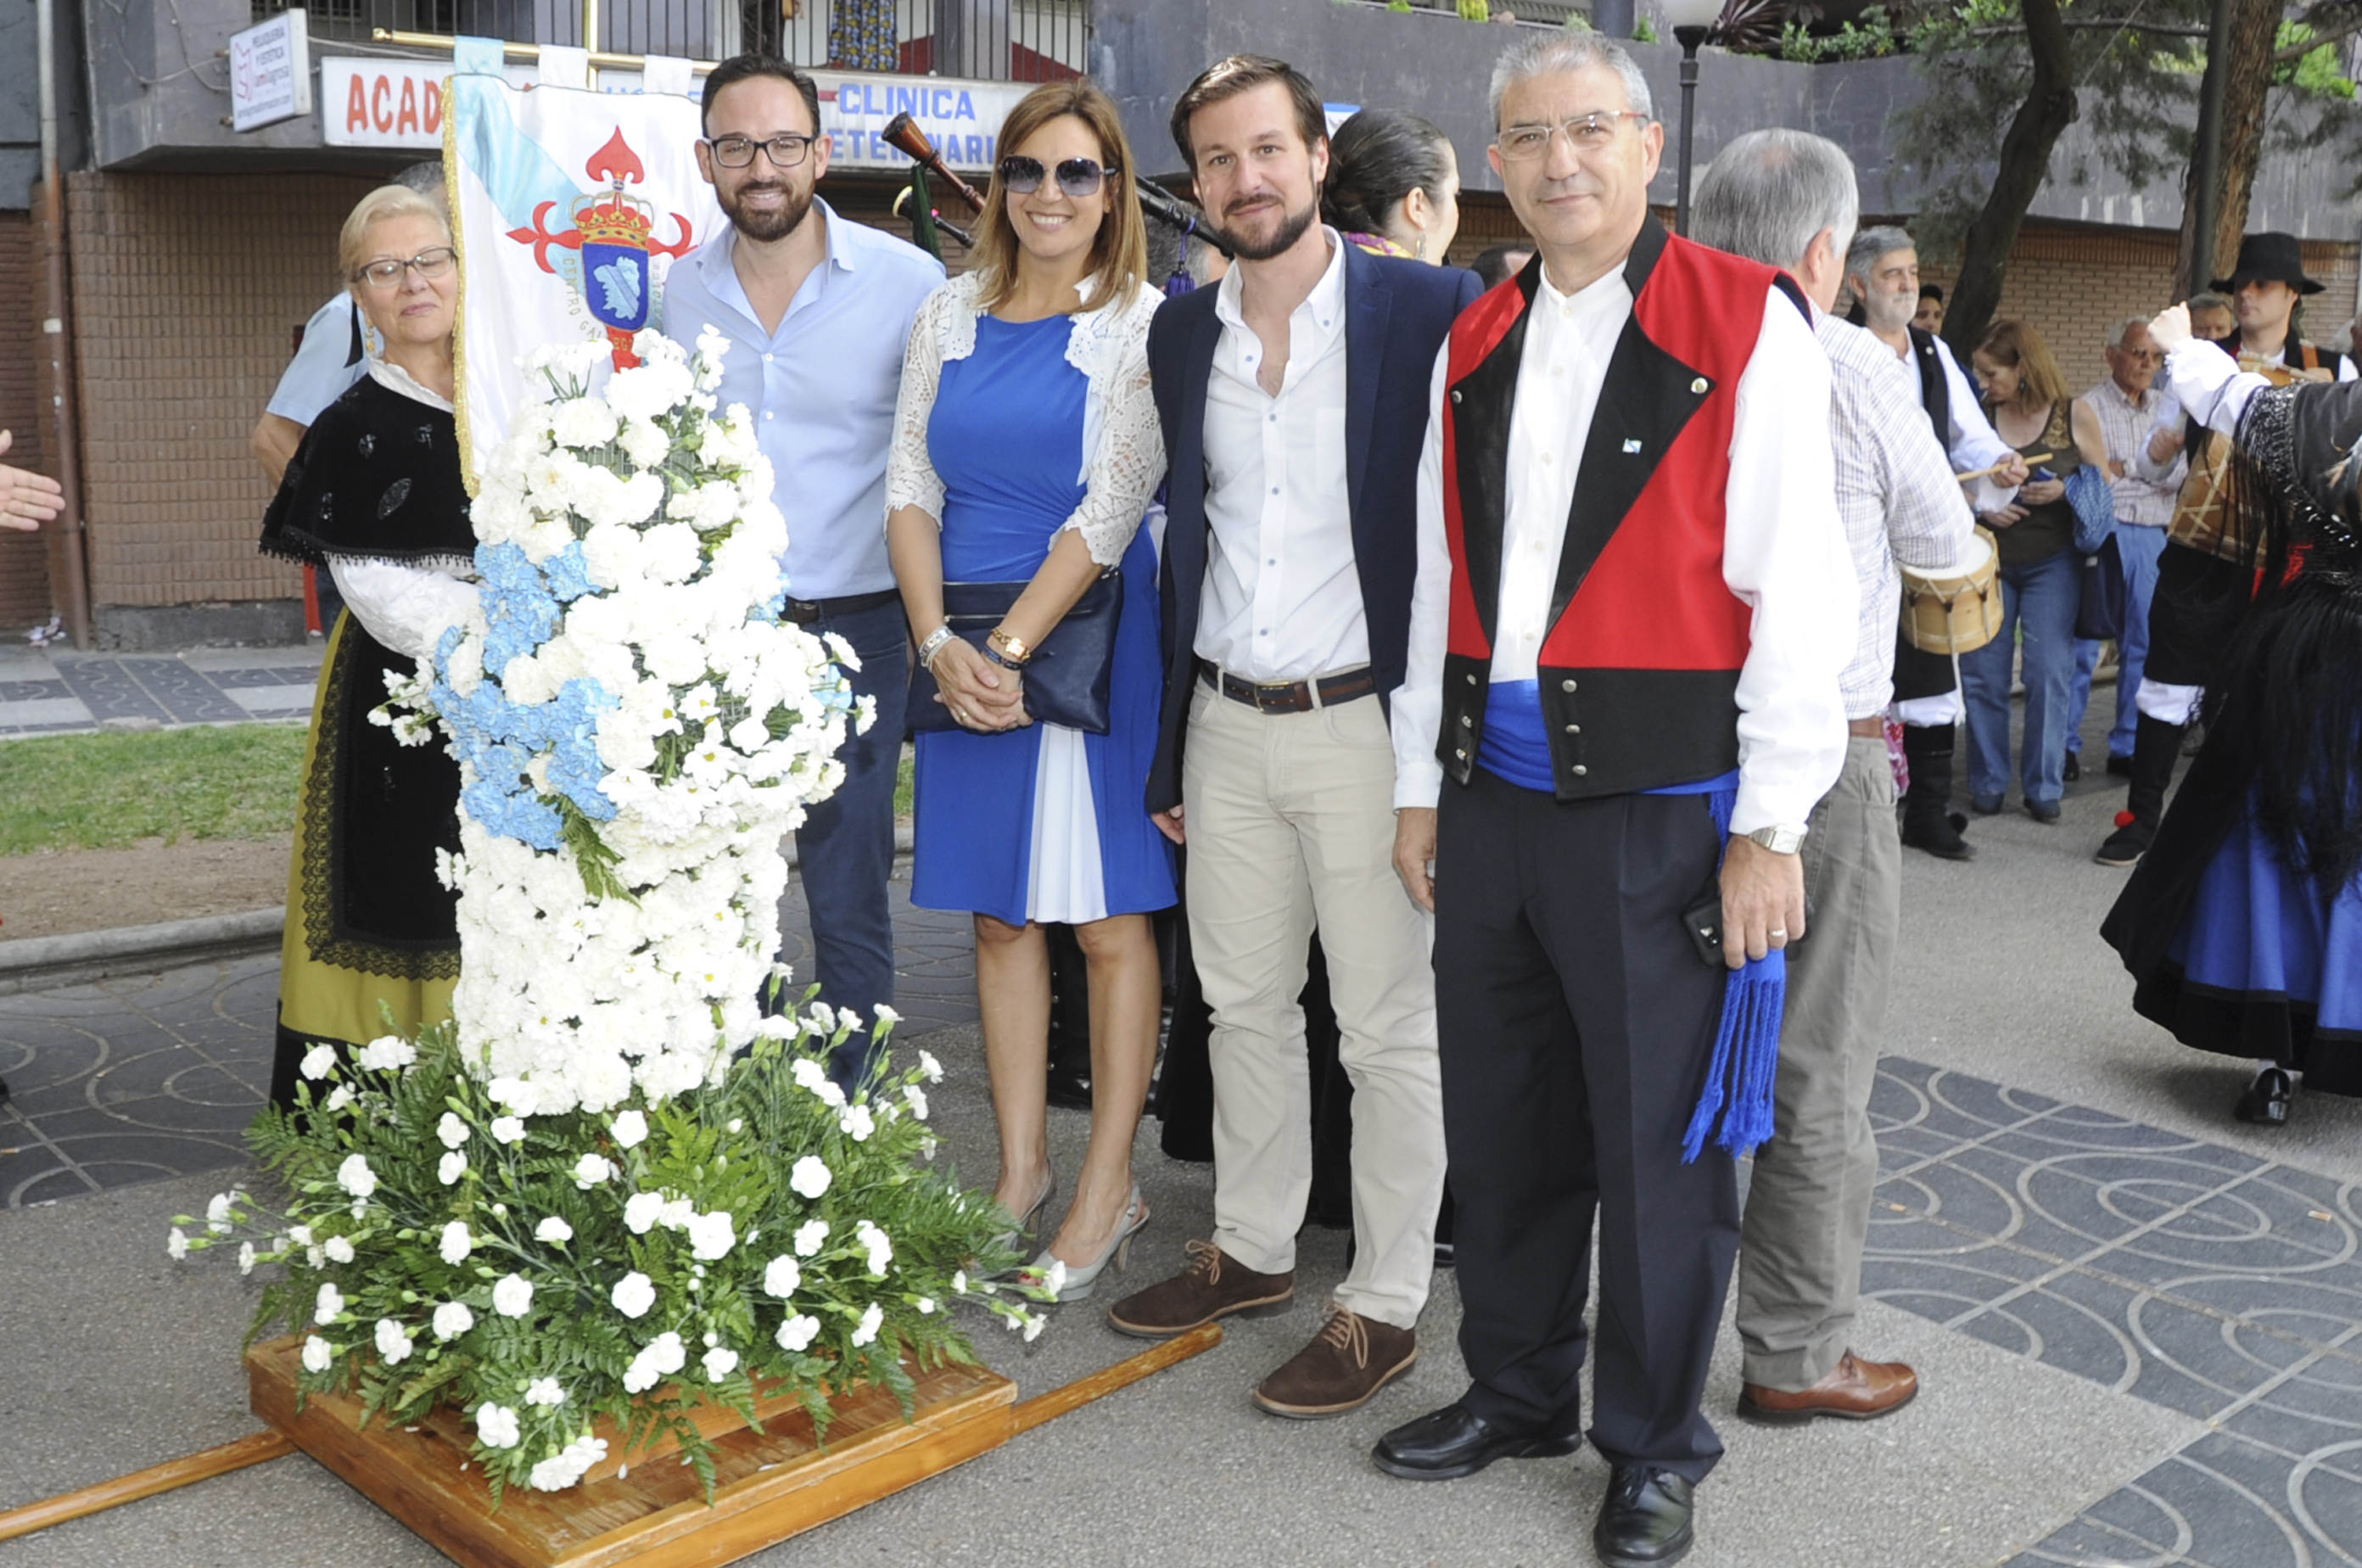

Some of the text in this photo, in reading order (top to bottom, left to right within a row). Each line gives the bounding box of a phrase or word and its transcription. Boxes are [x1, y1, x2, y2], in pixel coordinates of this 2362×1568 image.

[347, 73, 442, 135] ACAD
[839, 82, 976, 120] CLINICA
[563, 257, 581, 316] CENTRO
